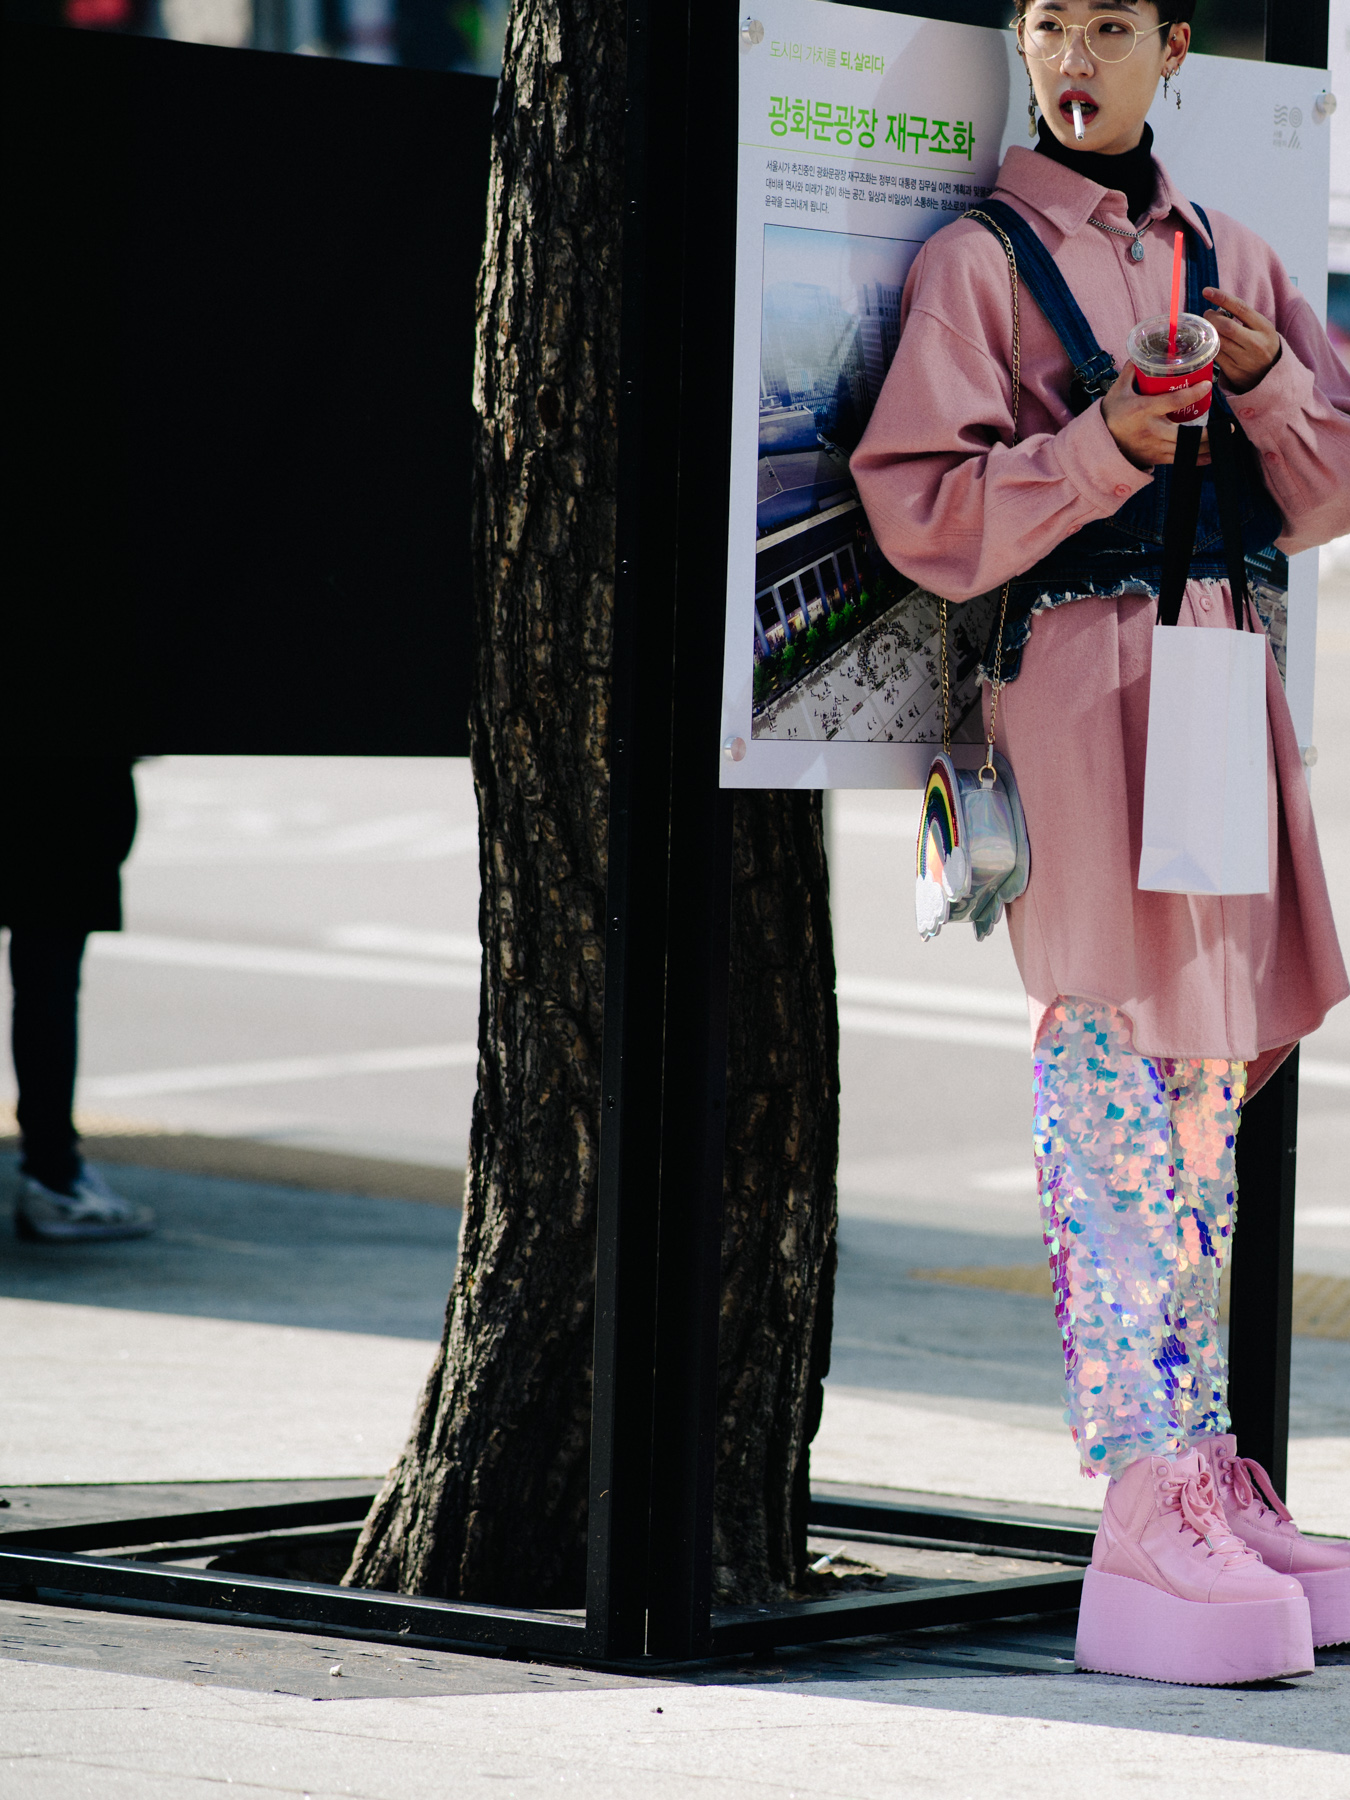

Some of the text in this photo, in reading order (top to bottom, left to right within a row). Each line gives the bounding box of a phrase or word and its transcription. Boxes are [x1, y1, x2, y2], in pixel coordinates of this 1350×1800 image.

[769, 41, 802, 62] 도시의
[805, 45, 836, 68] 가치를
[768, 95, 976, 161] 광화문광장 재구조화
[765, 178, 784, 190] 대비해
[785, 180, 804, 193] 역사와
[804, 183, 823, 196] 미래가
[824, 185, 837, 197] 같이
[838, 187, 851, 199] 하는
[868, 190, 887, 204] 일상과
[888, 193, 912, 207] 비일상이
[914, 196, 939, 210] 소통하는
[940, 199, 966, 212] 장소로의
[766, 160, 790, 174] 서울시가
[791, 163, 815, 178] 추진중인
[816, 166, 847, 181] 광화문광장
[848, 170, 877, 185] 재구조화는
[879, 174, 897, 187] 정부의
[899, 177, 917, 190] 대통령
[918, 179, 937, 192] 집무실
[938, 181, 952, 194] 이전
[953, 183, 972, 197] 계획과
[765, 194, 830, 213] 윤곽을 드러내게 됩니다.
